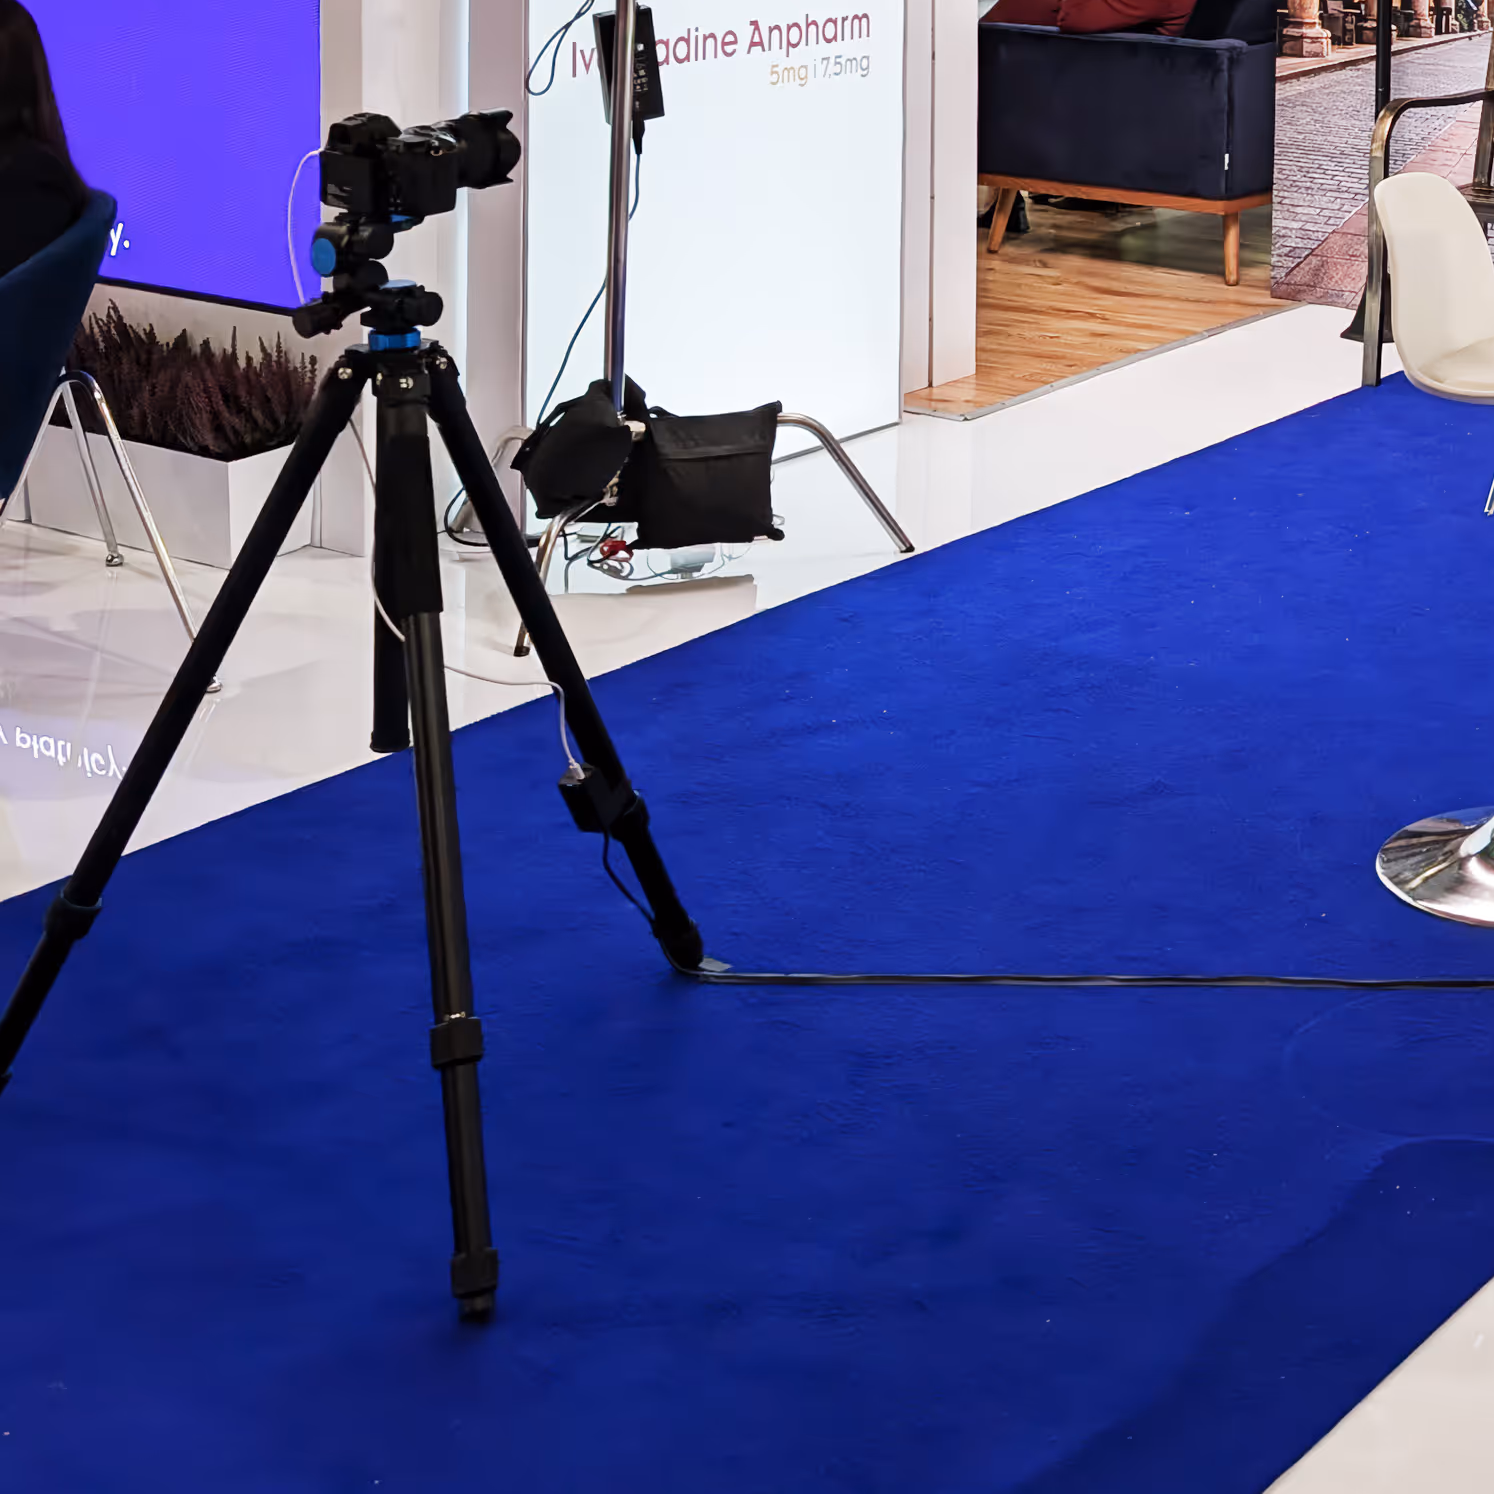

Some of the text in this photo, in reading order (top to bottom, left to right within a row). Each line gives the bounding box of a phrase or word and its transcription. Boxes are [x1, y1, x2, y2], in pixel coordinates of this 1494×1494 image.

[571, 26, 738, 78] Ivadine
[746, 12, 870, 58] Anpharm
[769, 62, 809, 87] 5mg
[820, 55, 871, 79] 7,5mg
